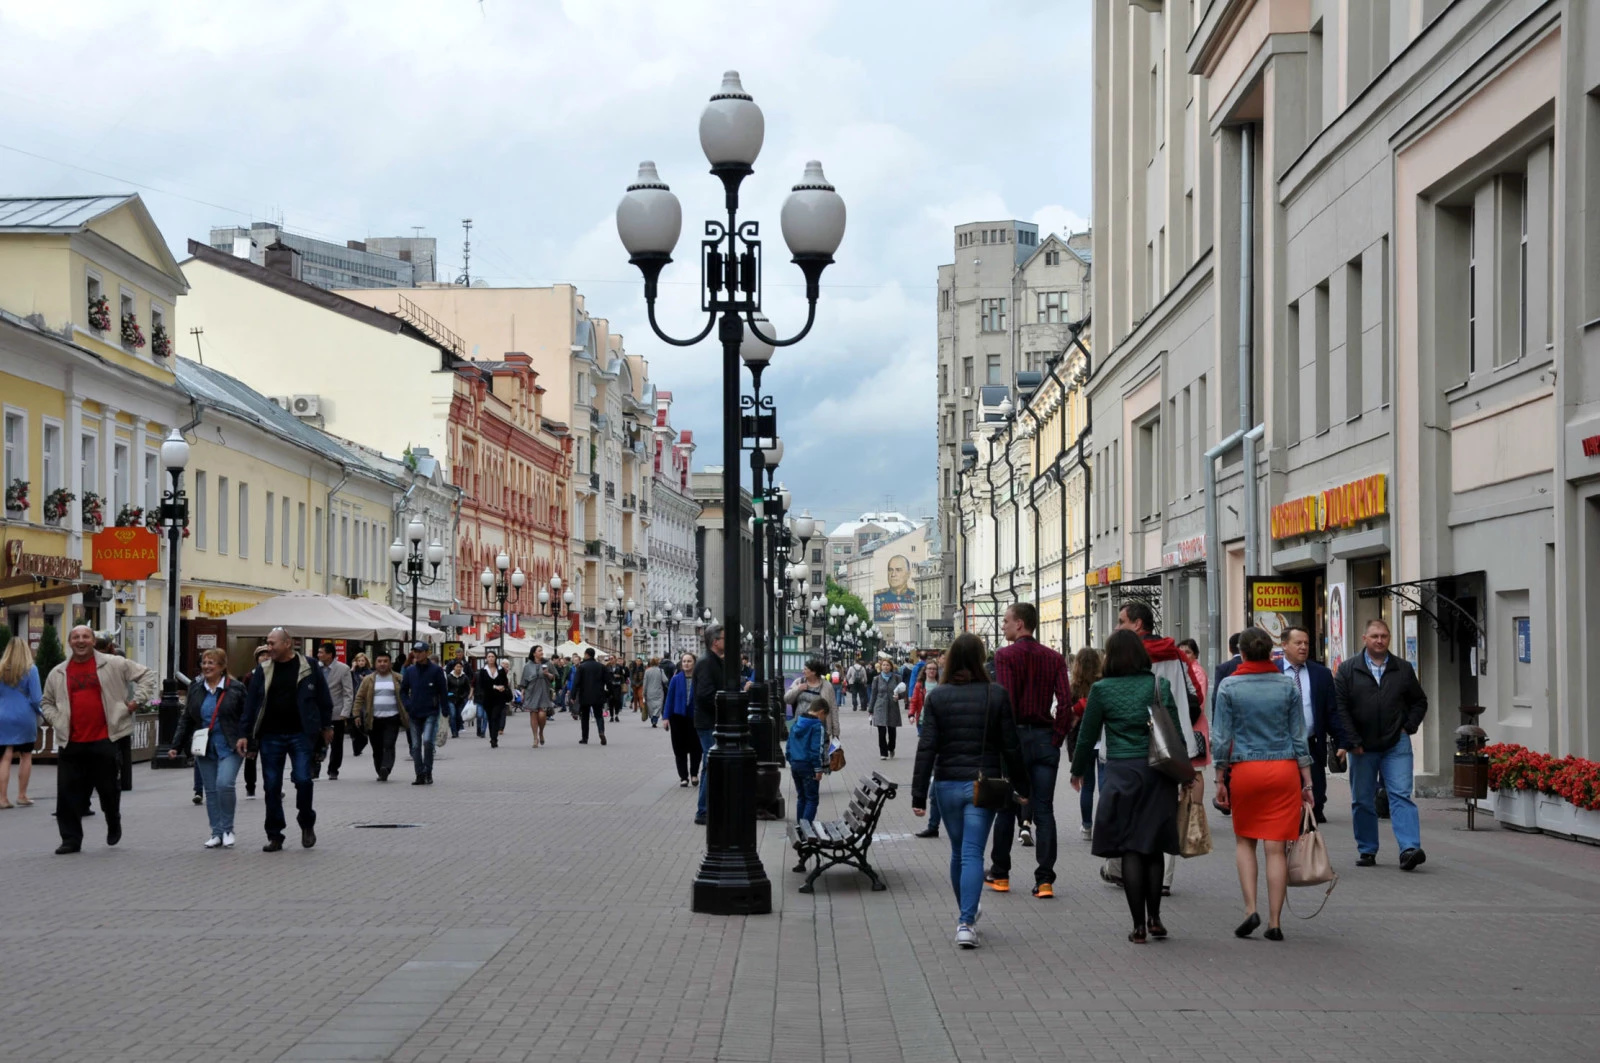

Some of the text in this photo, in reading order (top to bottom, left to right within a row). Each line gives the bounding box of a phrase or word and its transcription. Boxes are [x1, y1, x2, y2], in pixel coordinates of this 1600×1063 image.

[1328, 473, 1385, 529] ПОДАРКИ
[96, 548, 155, 560] ЛОМБАРД
[1257, 585, 1299, 595] СКУПКА
[1256, 597, 1300, 608] ОЦЕНКА
